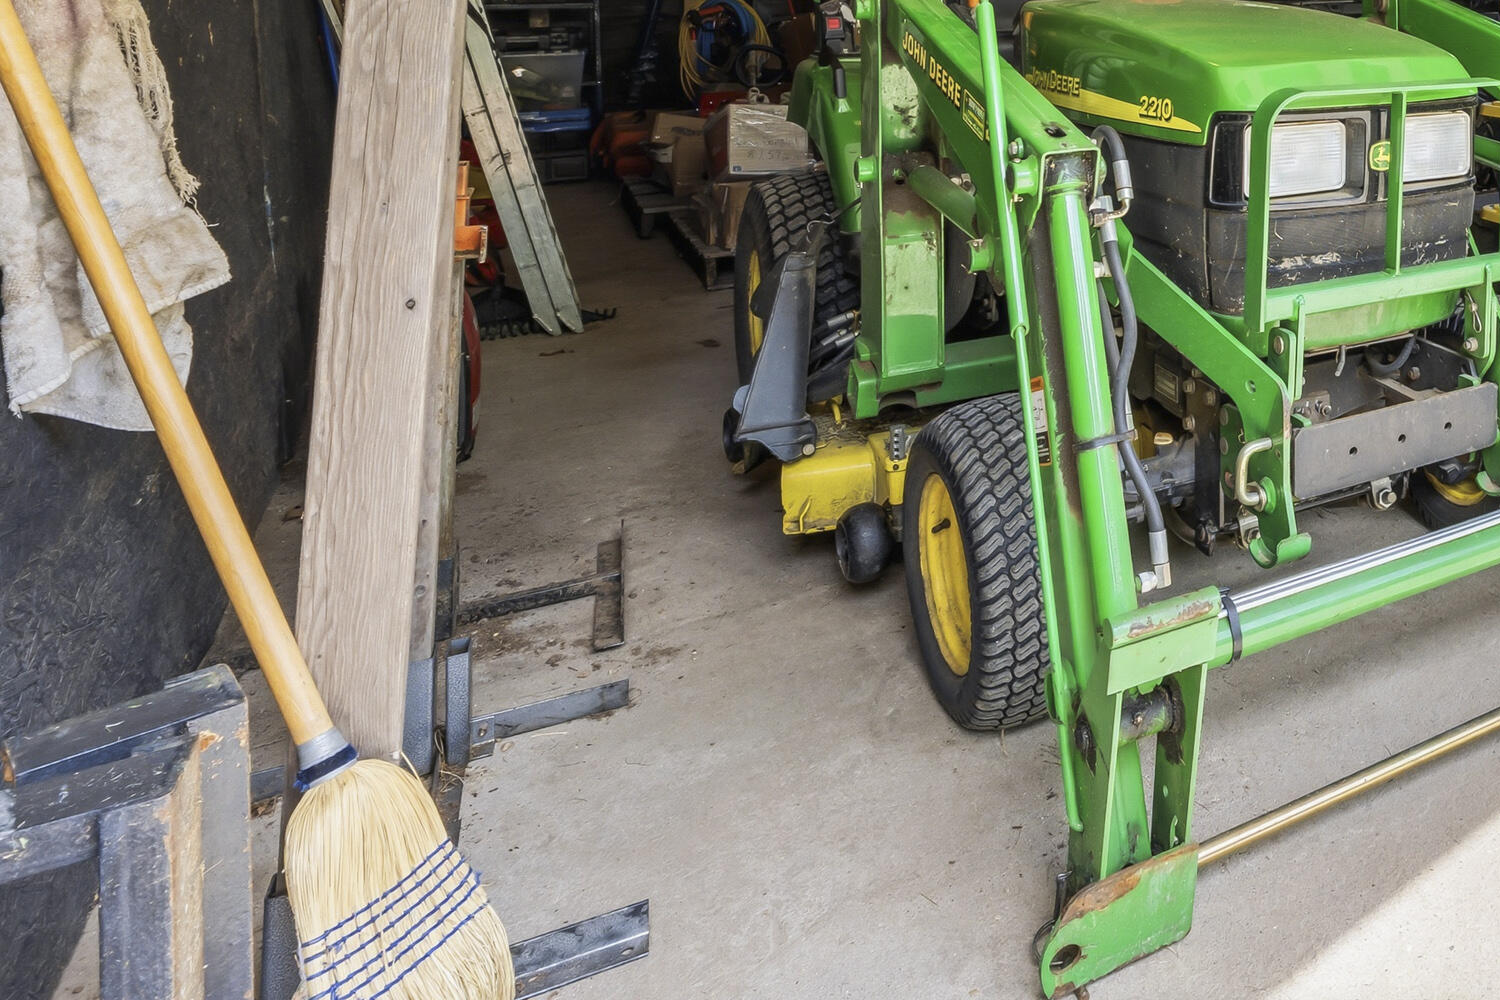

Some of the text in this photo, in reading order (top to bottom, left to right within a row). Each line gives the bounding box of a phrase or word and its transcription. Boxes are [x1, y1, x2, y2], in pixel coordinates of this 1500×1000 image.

[902, 31, 961, 108] JOHN DEERE
[1050, 69, 1081, 96] DEERE
[1138, 95, 1173, 121] 2210
